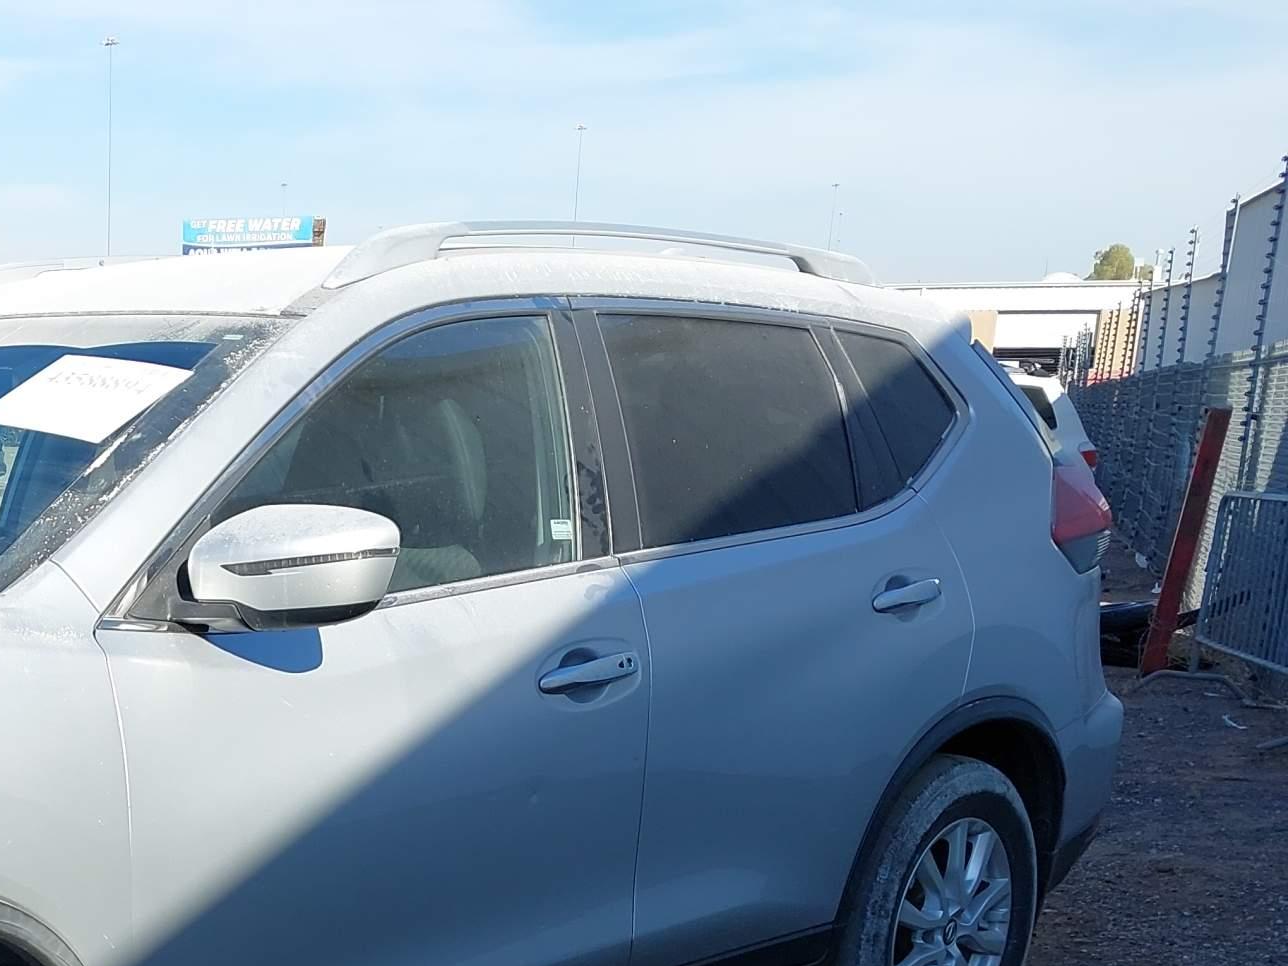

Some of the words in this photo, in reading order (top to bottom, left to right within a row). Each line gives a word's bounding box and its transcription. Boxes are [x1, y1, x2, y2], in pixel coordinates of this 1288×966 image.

[190, 220, 208, 229] GET
[208, 218, 245, 233] FREE
[247, 217, 301, 231] WATER
[196, 234, 214, 243] FOR
[215, 233, 240, 242] LAWN
